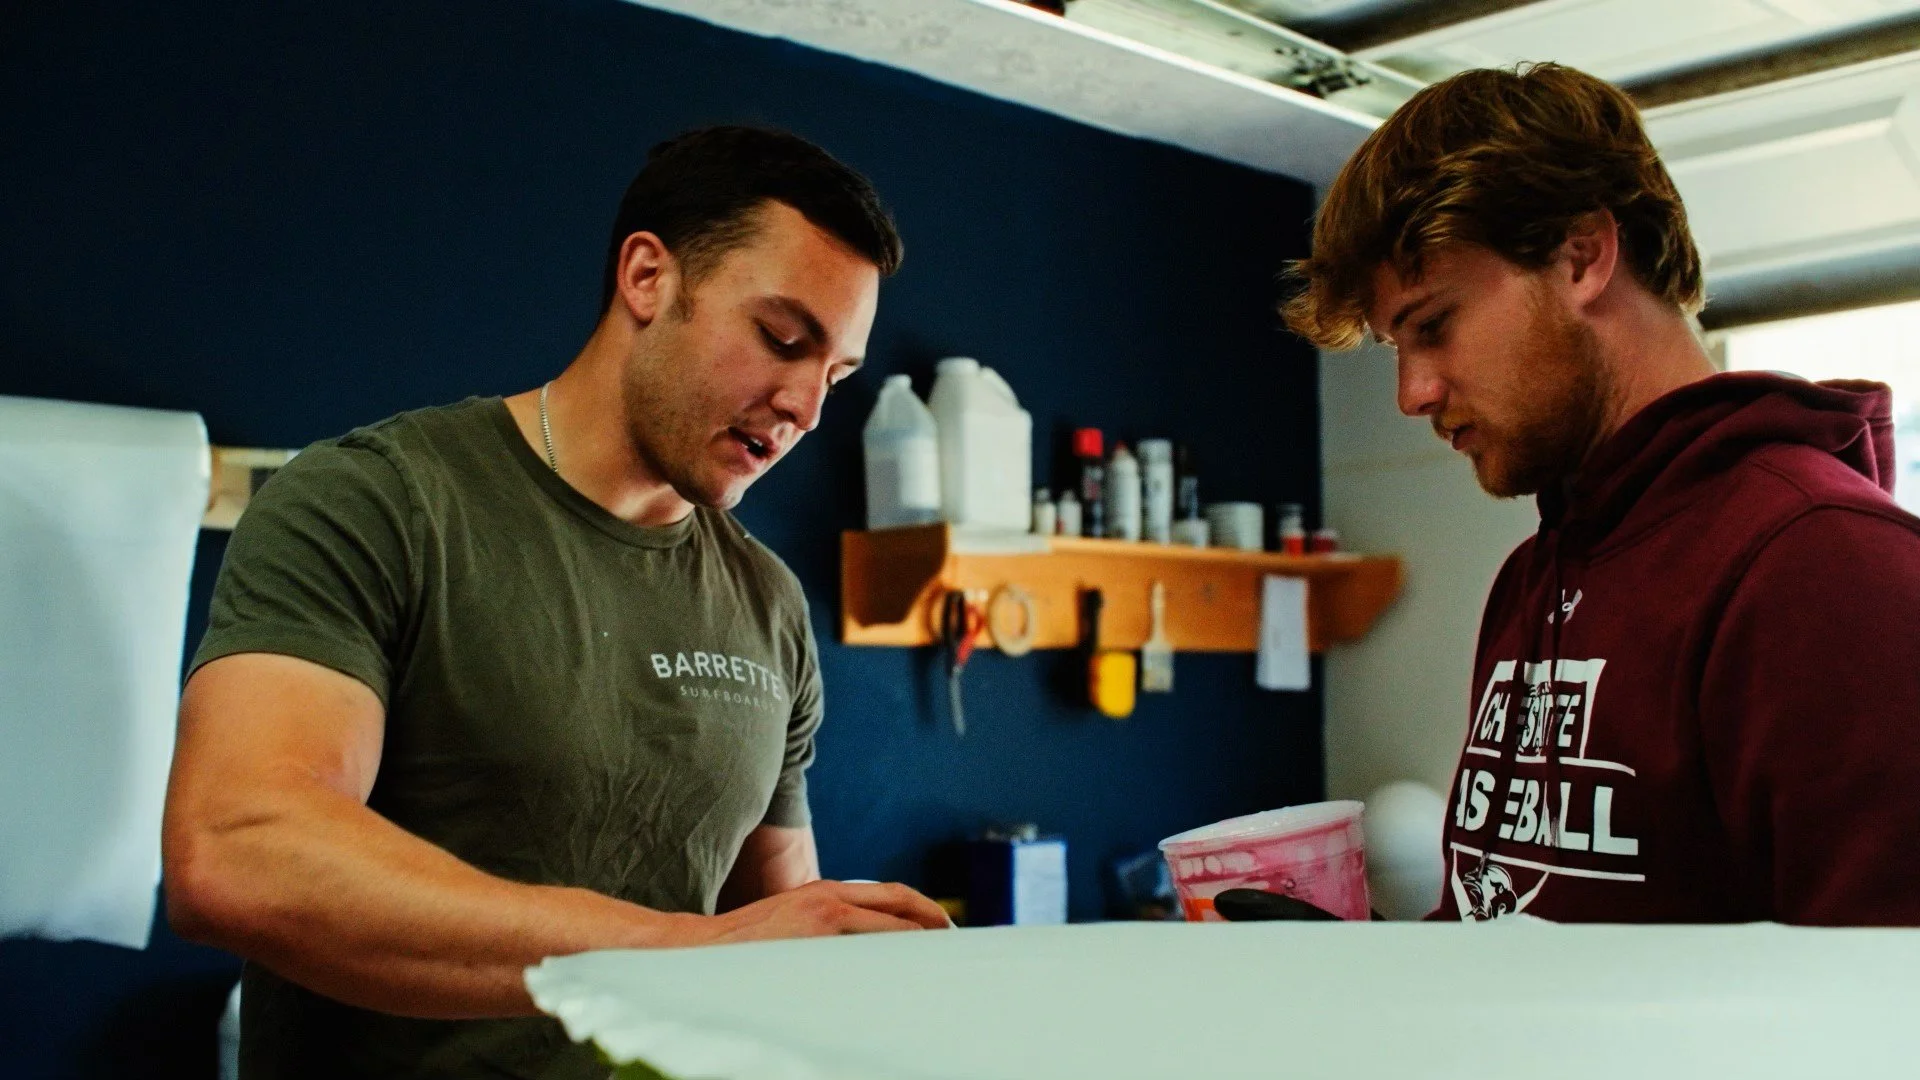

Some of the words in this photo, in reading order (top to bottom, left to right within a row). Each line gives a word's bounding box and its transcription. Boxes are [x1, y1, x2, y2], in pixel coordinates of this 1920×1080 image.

[650, 652, 782, 701] BARRETTE
[680, 685, 776, 713] SURFBOAR
[1455, 768, 1639, 855] ASEBALL
